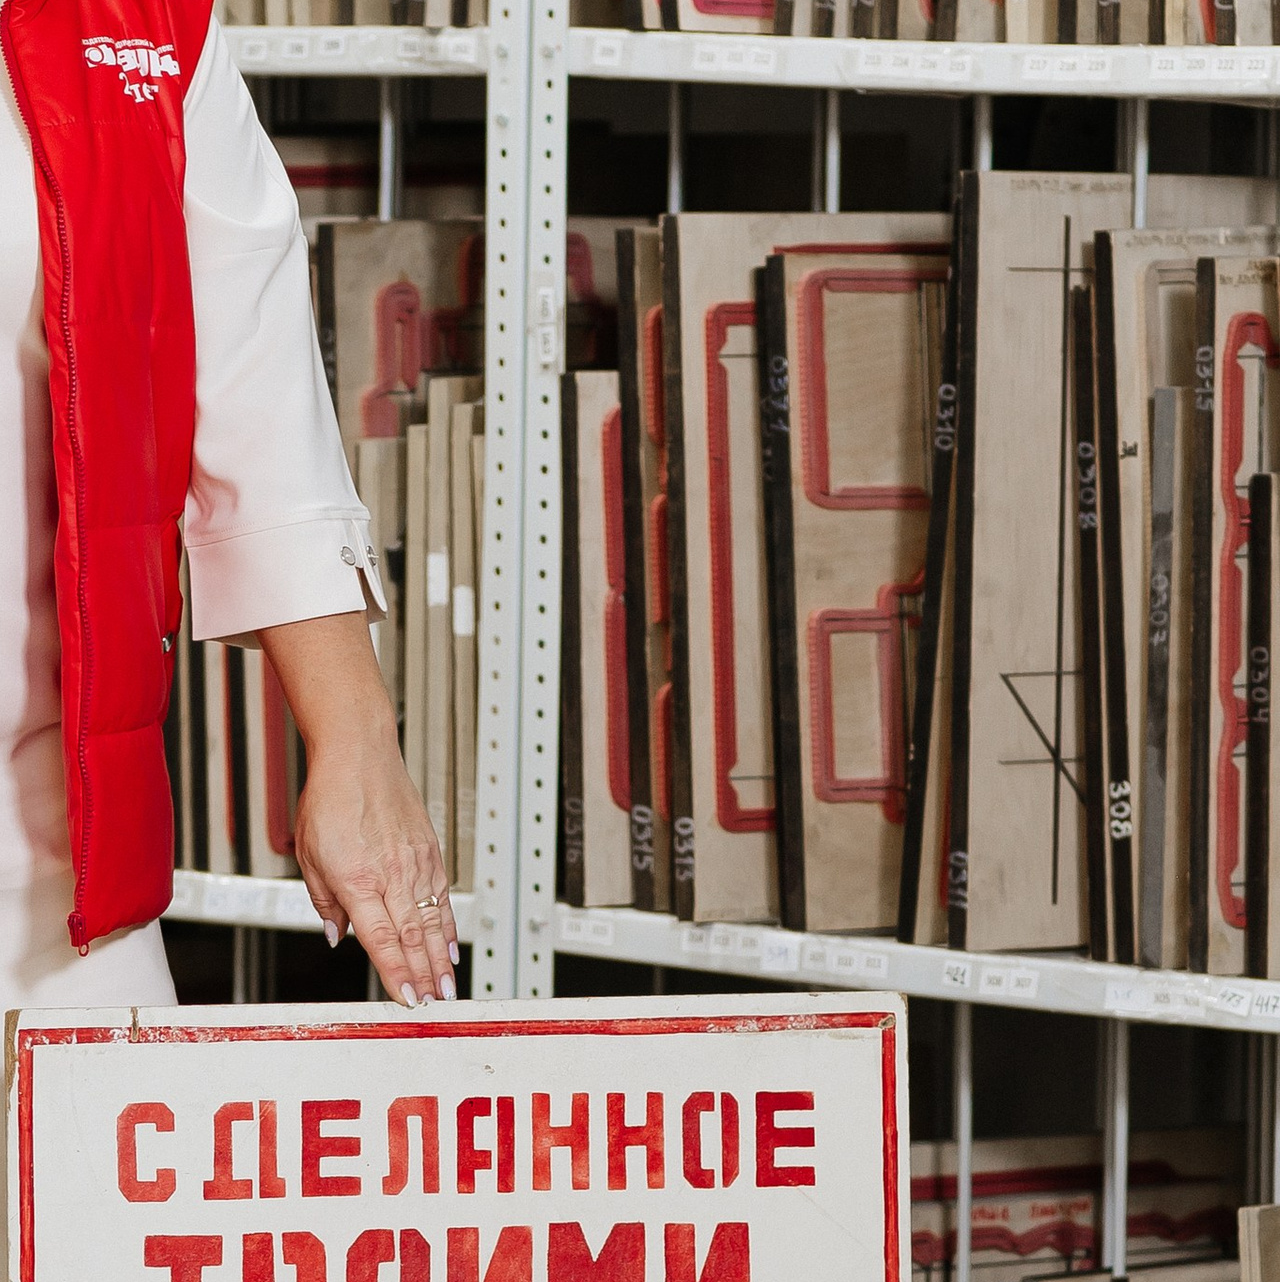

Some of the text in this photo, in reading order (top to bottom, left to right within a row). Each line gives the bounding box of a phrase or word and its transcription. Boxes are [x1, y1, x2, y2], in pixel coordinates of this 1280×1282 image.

[934, 383, 958, 451] 0310
[1250, 646, 1269, 724] 0304
[1108, 779, 1133, 840] 308
[117, 1090, 817, 1203] СДЕЛАННОЕ
